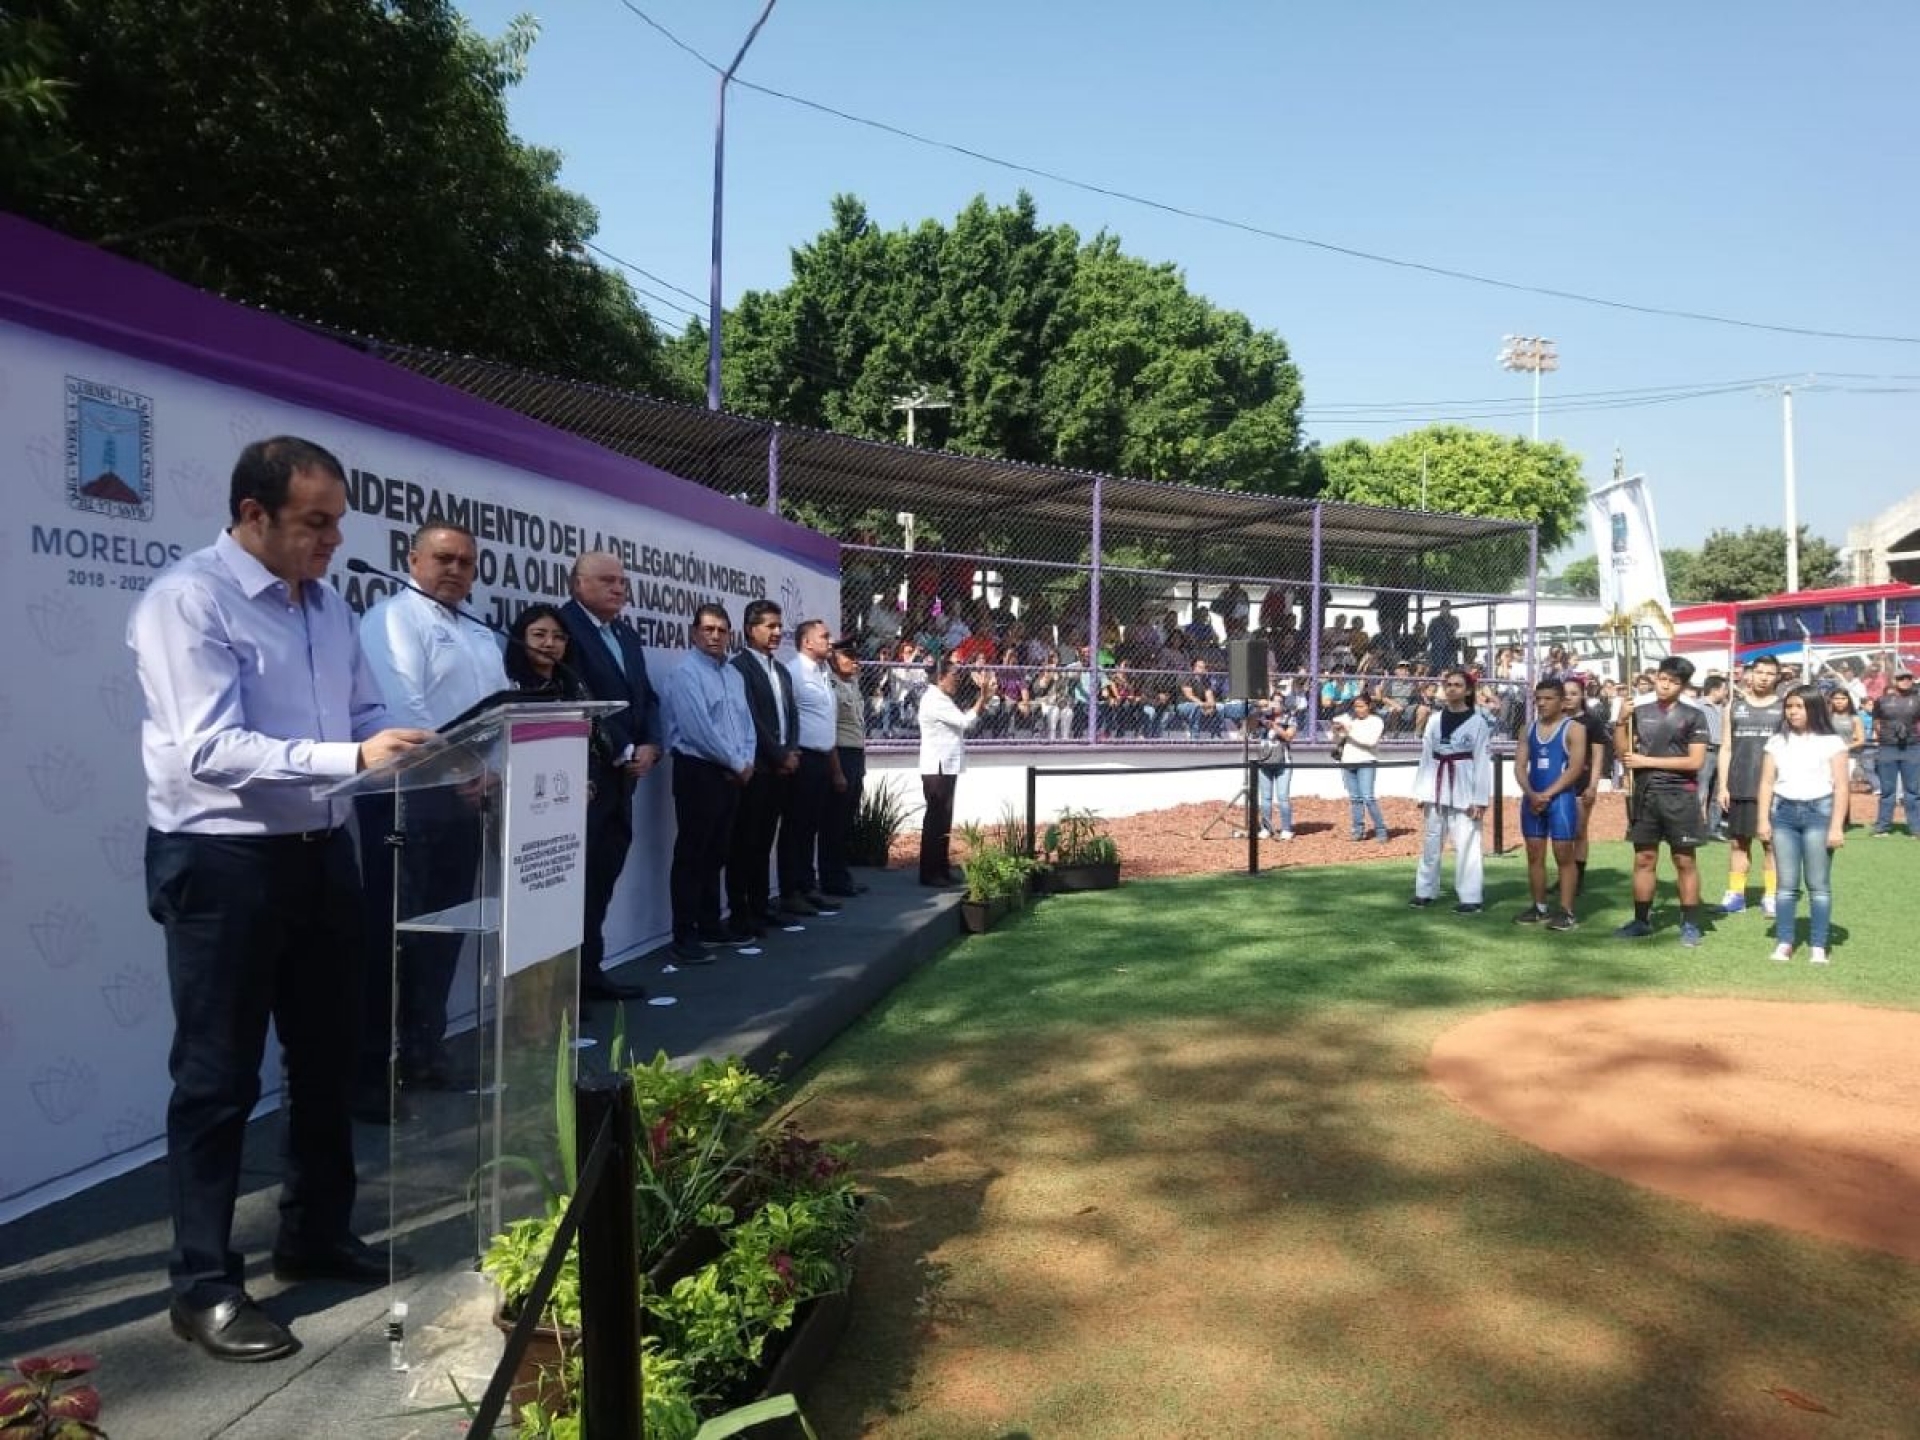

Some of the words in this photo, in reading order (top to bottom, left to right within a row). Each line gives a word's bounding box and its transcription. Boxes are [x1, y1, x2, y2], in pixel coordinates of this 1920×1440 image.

[32, 525, 182, 569] MORELOS
[346, 468, 545, 552] NDERAMIENTO
[550, 520, 577, 557] DE
[608, 536, 707, 587] DELEGACIÓN
[710, 563, 766, 600] MORELOS
[67, 569, 105, 587] 2018
[502, 553, 520, 590] A
[637, 616, 686, 649] ETAPA
